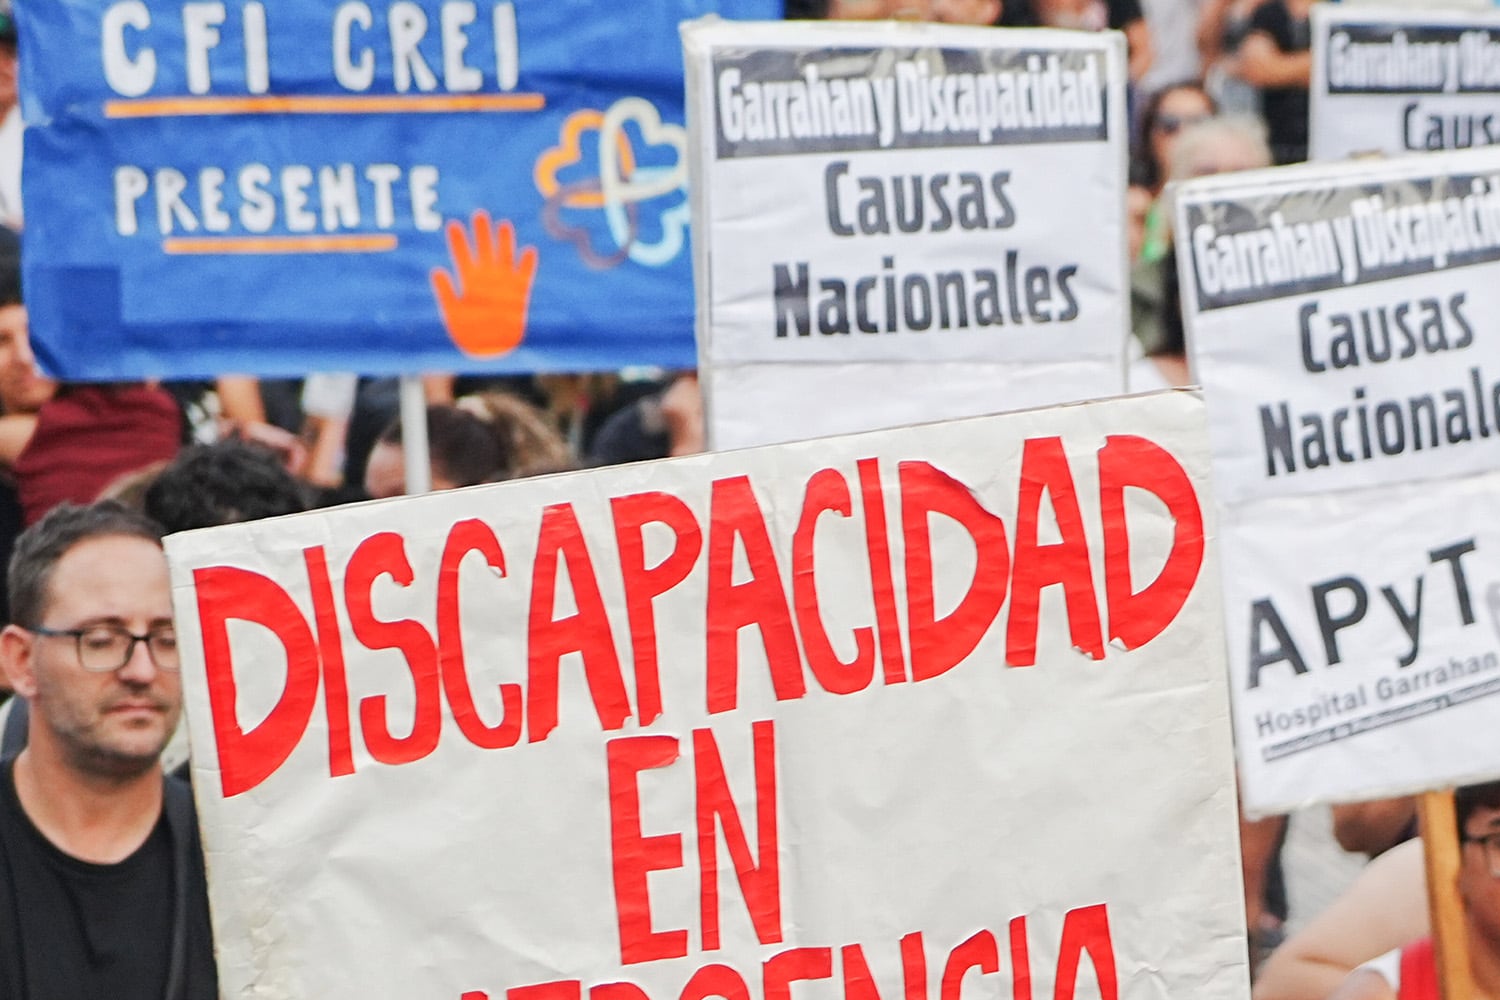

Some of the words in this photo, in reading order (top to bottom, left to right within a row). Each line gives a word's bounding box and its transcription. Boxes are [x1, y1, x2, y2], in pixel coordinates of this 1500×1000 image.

[101, 0, 270, 96] CFI
[331, 0, 520, 93] CREI
[718, 63, 875, 143] Garrahan
[873, 76, 897, 148] y
[896, 54, 1102, 144] Discapacidad
[114, 163, 444, 235] PRESENTE
[822, 161, 1017, 238] Causas
[772, 250, 1080, 339] Nacionales
[1194, 209, 1344, 297] Garrahan
[1332, 214, 1361, 285] y
[1300, 292, 1476, 376] Causas
[194, 436, 1204, 797] DISCAPACIDAD
[1246, 536, 1478, 690] APyT
[1254, 684, 1368, 738] Hospital
[1375, 651, 1499, 702] Garrahan
[606, 720, 782, 965] EN
